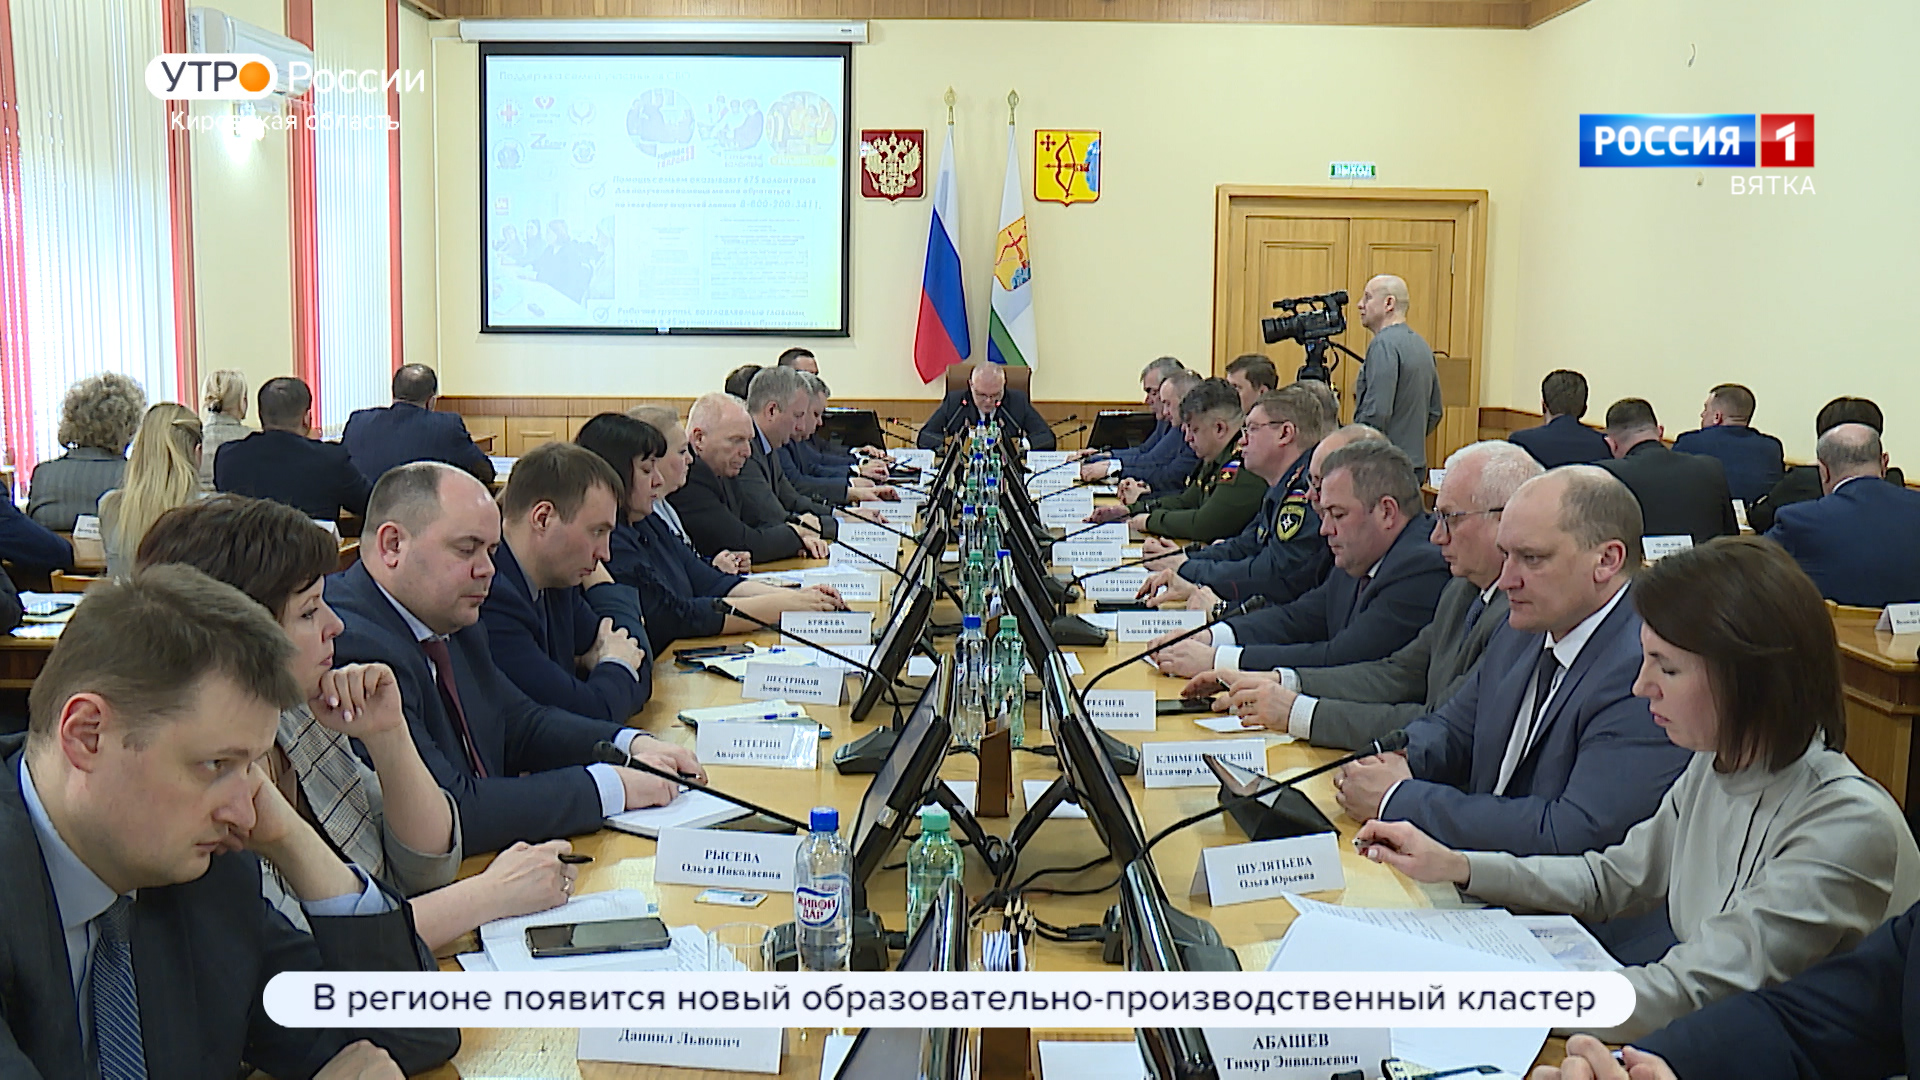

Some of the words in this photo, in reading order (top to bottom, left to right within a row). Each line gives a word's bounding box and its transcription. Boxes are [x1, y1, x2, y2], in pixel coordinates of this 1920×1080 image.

[733, 739, 782, 749] ТЕТЕРИН
[704, 849, 760, 864] РЫСЕВА
[681, 863, 714, 875] Ольга
[717, 865, 781, 880] Николаевна
[1236, 856, 1313, 876] ШУЛЯТЬЕВА
[1239, 878, 1269, 889] Ольга
[1271, 872, 1315, 887] Юрьевна
[677, 1031, 741, 1049] Львович
[1252, 1033, 1330, 1051] АБАШЕВ
[1224, 1055, 1270, 1073] Тимур
[1273, 1053, 1360, 1070] Энвильевич
